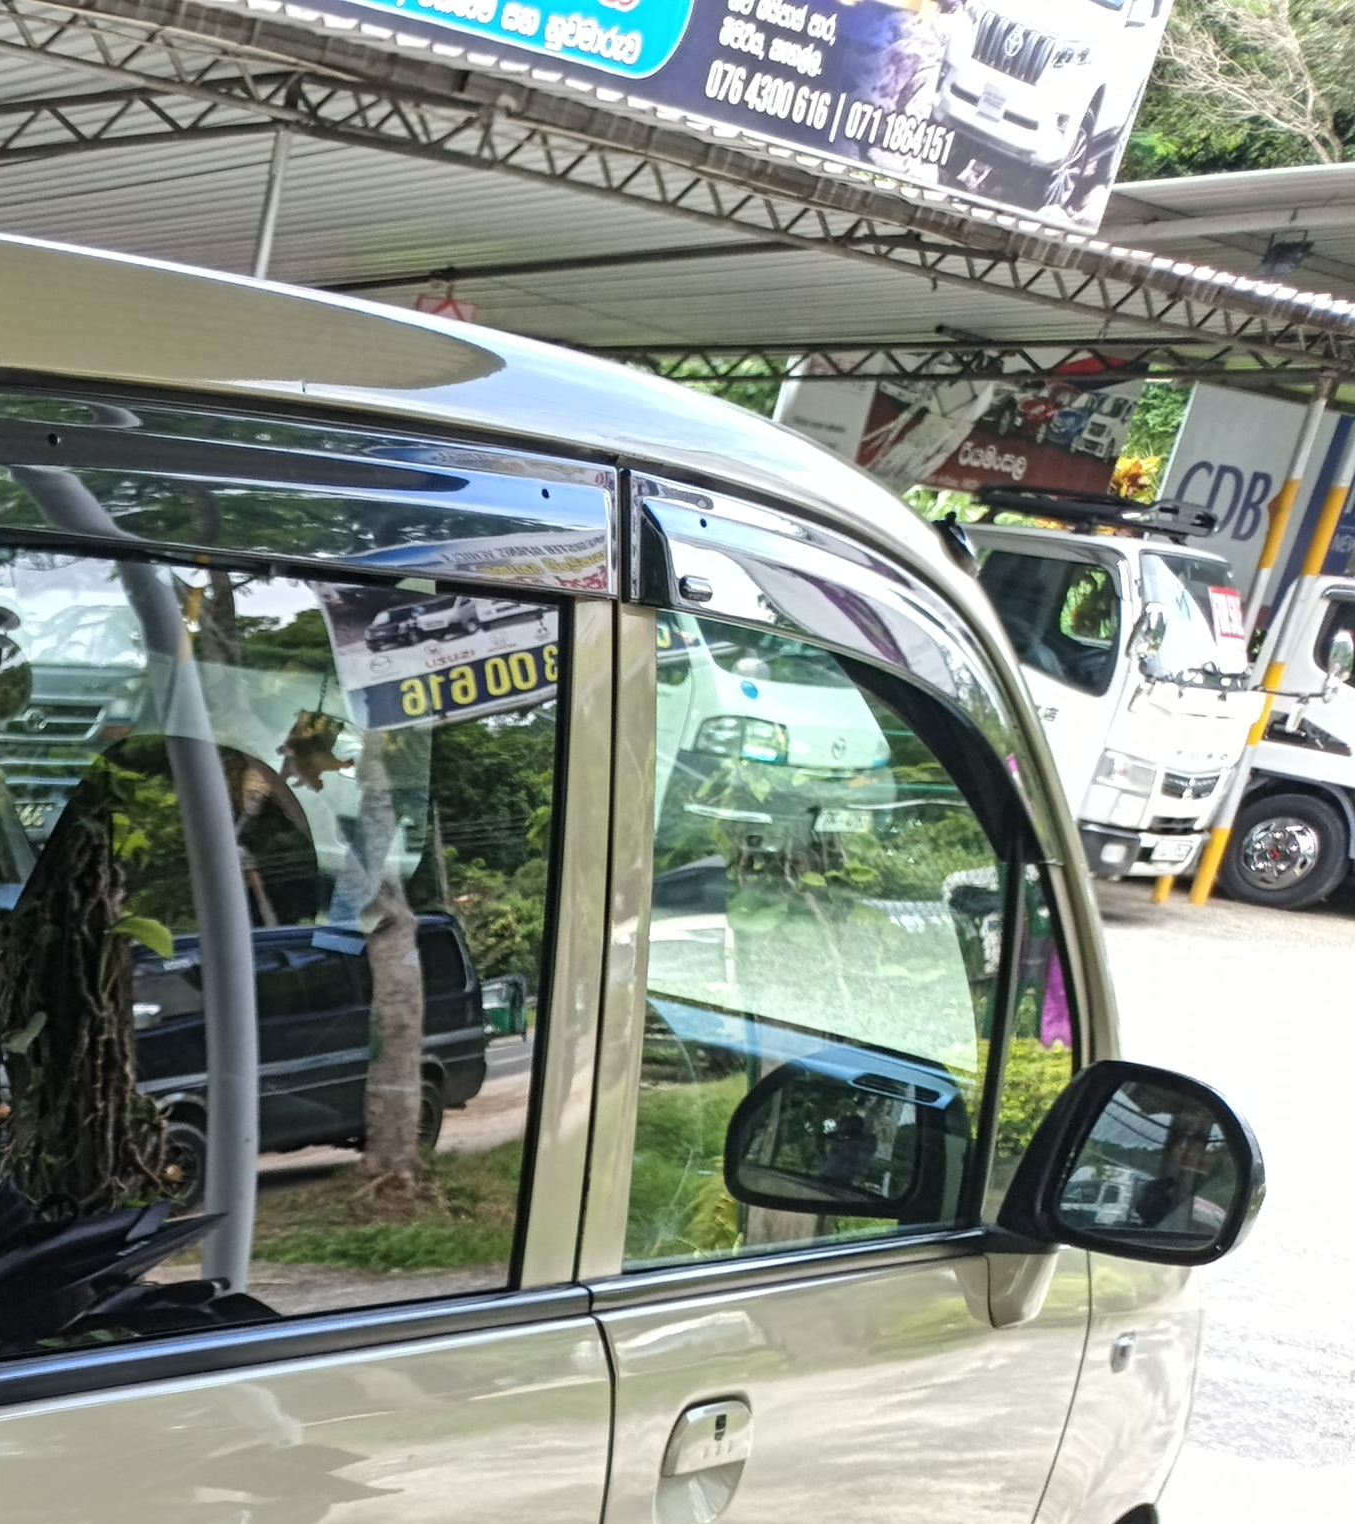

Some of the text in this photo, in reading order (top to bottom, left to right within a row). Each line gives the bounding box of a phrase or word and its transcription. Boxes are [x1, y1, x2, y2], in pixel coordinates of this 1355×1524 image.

[705, 59, 746, 105] 076
[744, 72, 795, 119] 4300
[792, 85, 832, 130] 616
[844, 101, 883, 144] 071
[883, 111, 956, 166] 1864151
